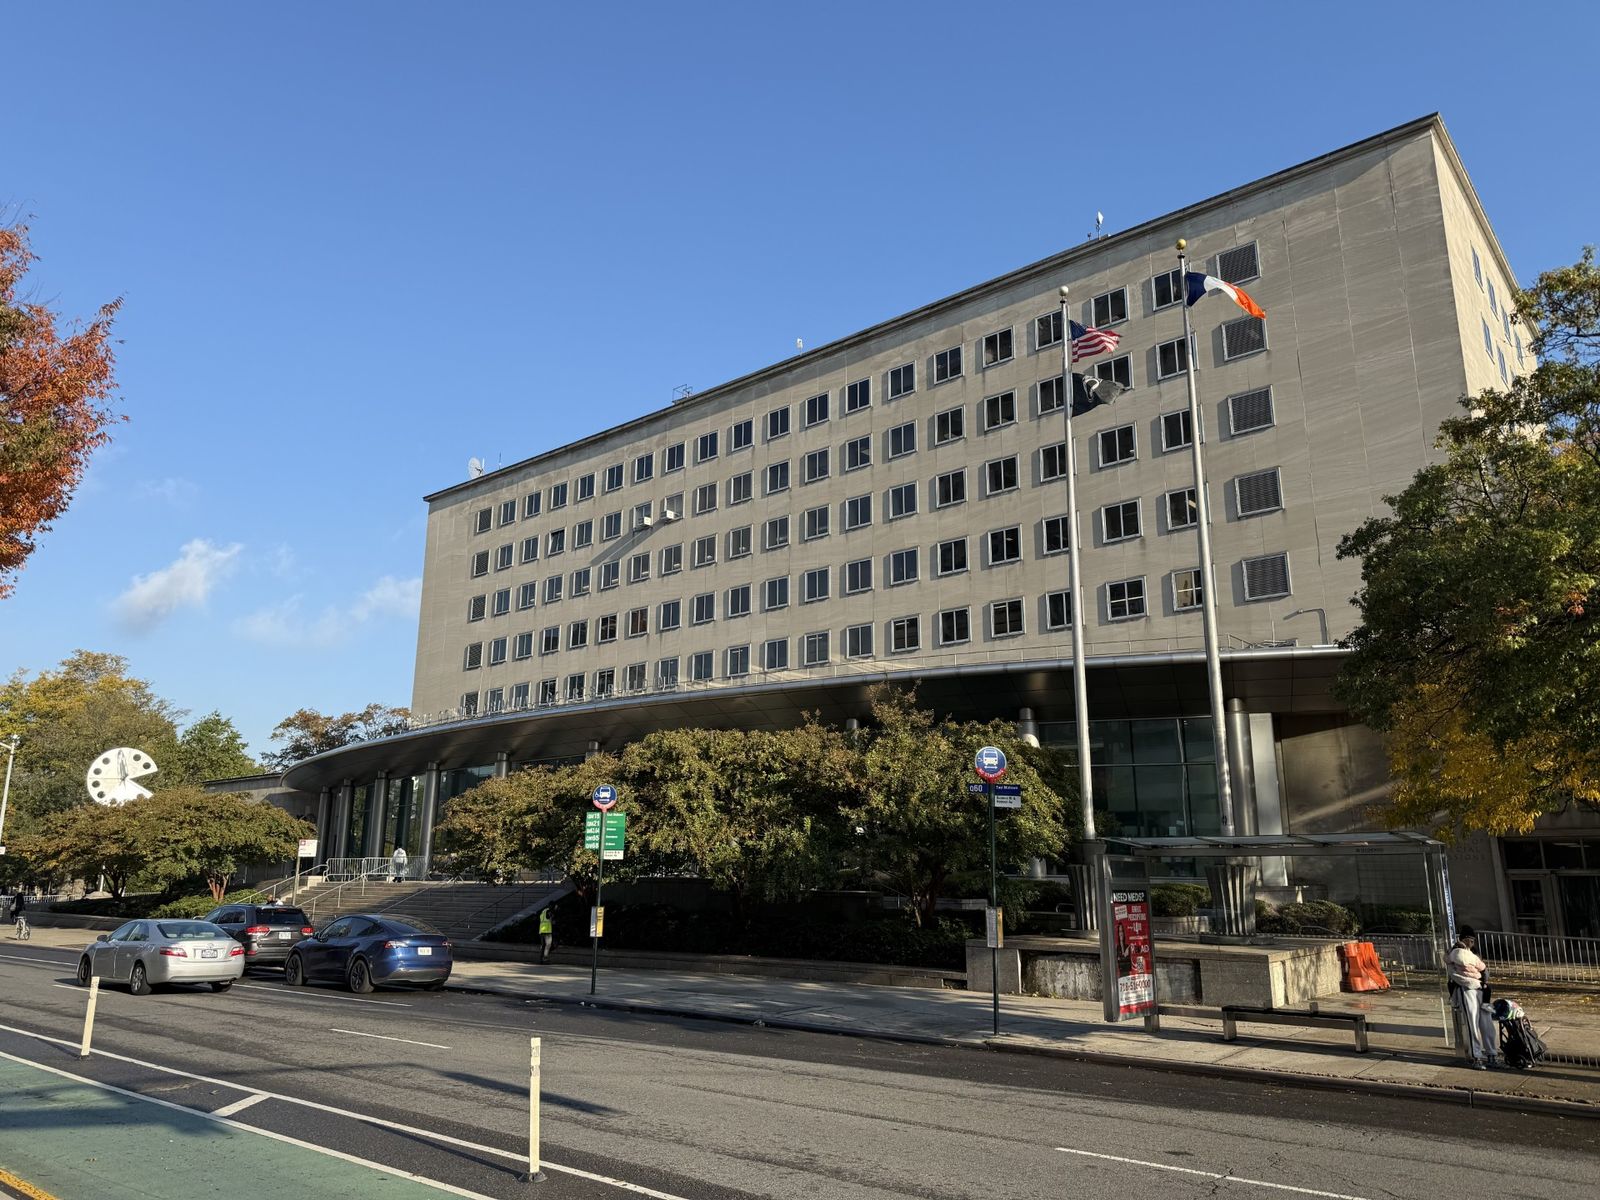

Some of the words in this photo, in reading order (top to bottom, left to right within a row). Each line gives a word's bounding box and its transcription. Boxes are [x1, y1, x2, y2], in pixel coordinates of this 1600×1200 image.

[969, 784, 983, 792] Q60
[1113, 892, 1128, 902] NEED
[1127, 892, 1145, 902] MEDS?
